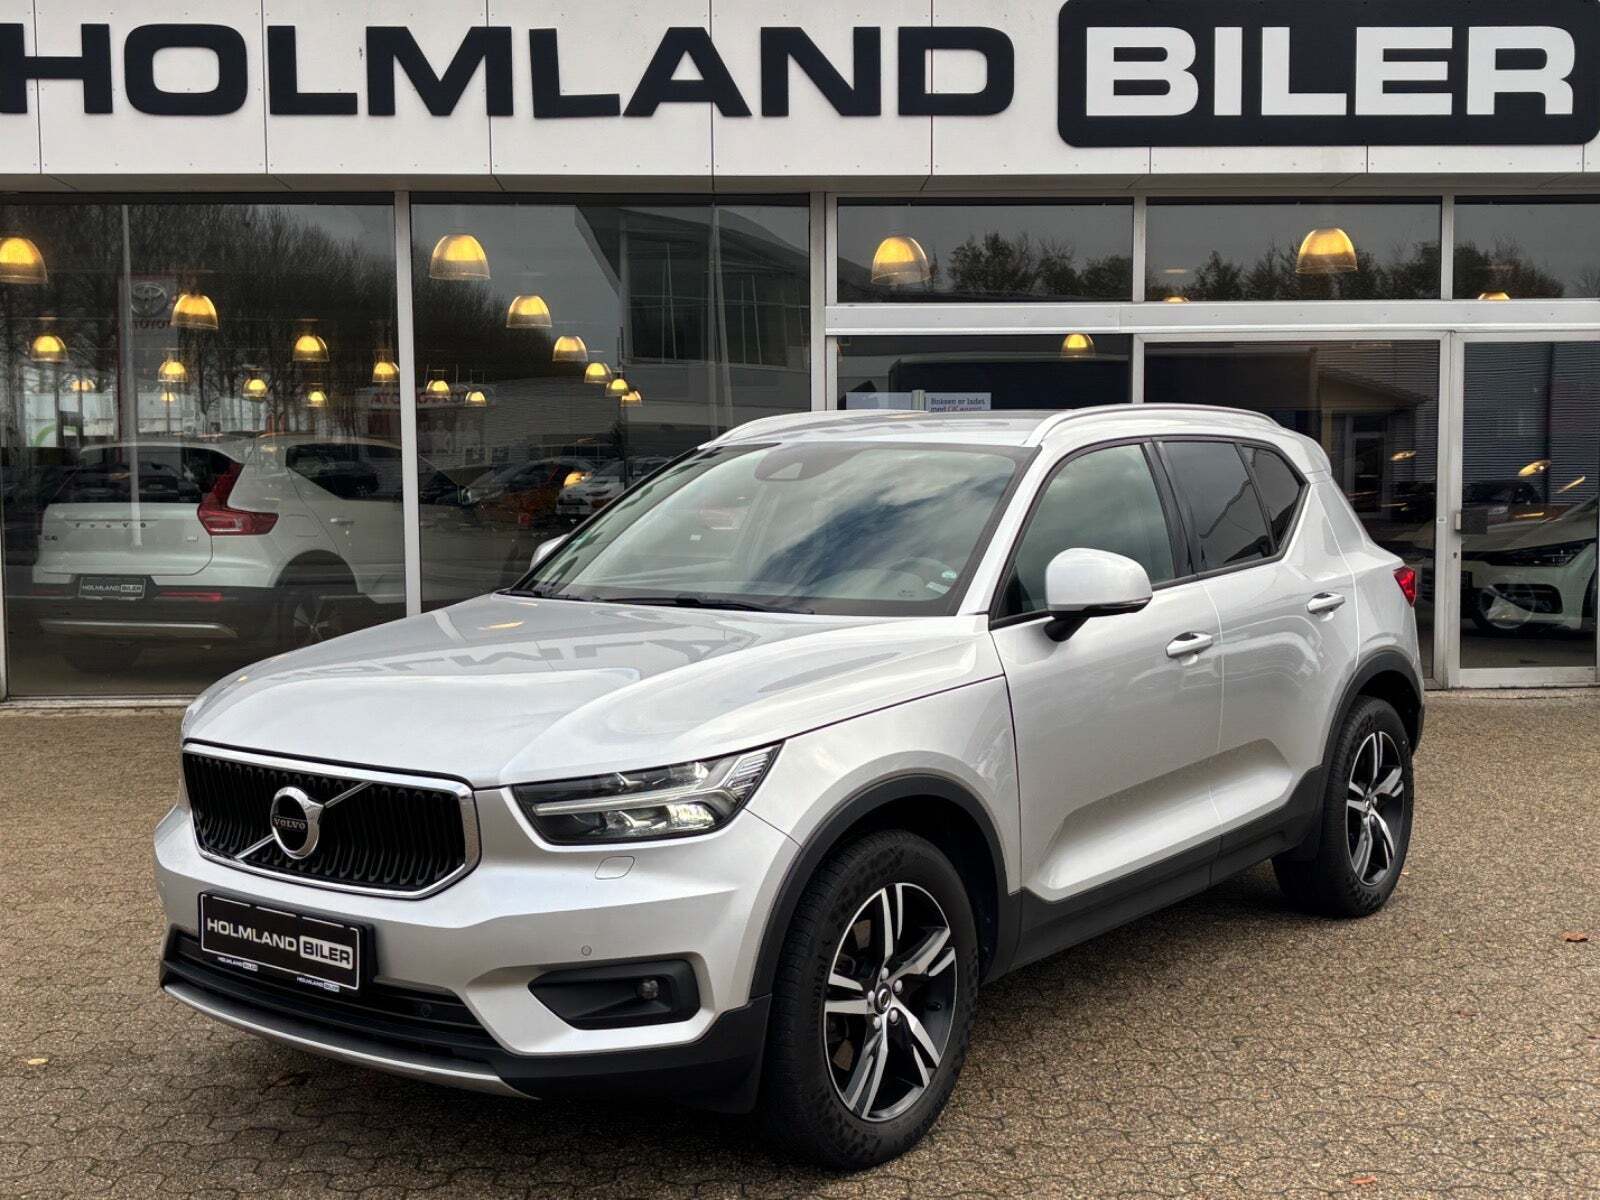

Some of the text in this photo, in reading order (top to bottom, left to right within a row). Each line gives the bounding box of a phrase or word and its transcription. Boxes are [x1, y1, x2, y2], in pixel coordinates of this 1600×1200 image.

[0, 23, 1575, 117] HOLMLAND BILER
[273, 817, 306, 830] VOLVO
[206, 917, 351, 966] HOLMLAND BILER
